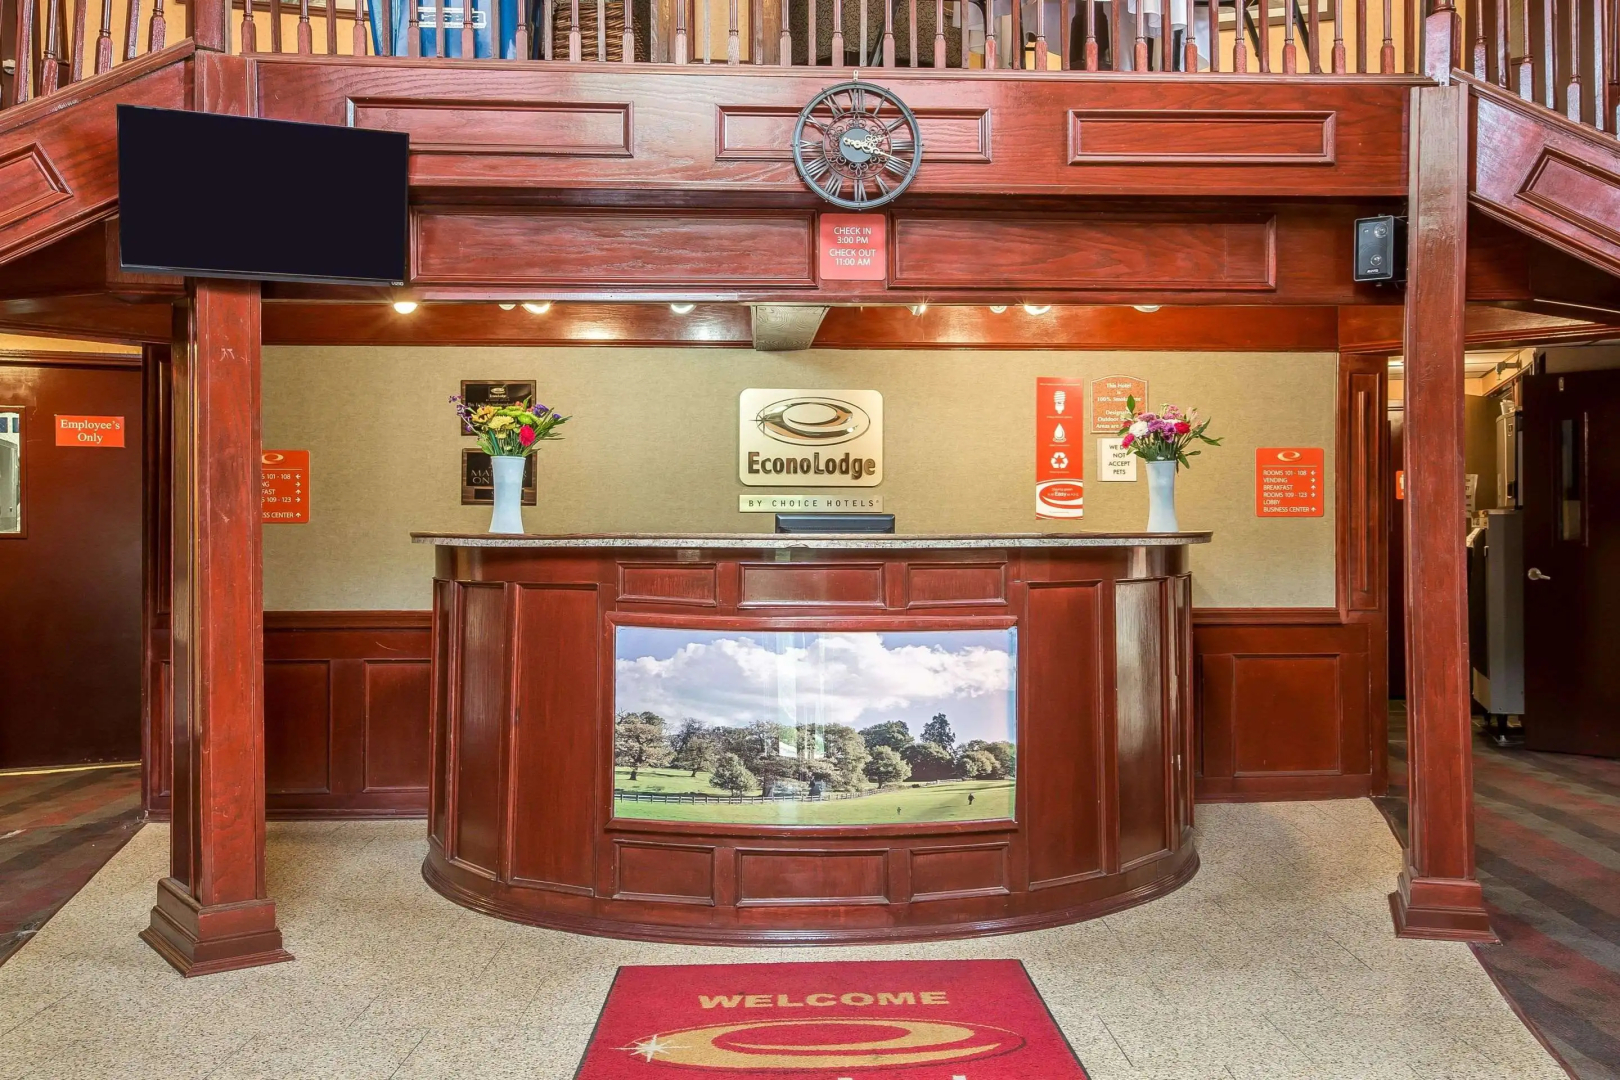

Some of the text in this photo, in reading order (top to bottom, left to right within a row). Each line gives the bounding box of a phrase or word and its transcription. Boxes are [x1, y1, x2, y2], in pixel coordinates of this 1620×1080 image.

[833, 227, 872, 235] CHECK IN
[836, 236, 869, 244] 3:00 PM
[829, 248, 876, 257] CHECK OUT
[835, 258, 871, 266] 11:00 AM
[60, 419, 121, 432] Employee's
[77, 432, 103, 445] Only
[747, 451, 876, 480] EconoLodge
[472, 476, 490, 484] ON
[698, 991, 950, 1008] WELCOME
